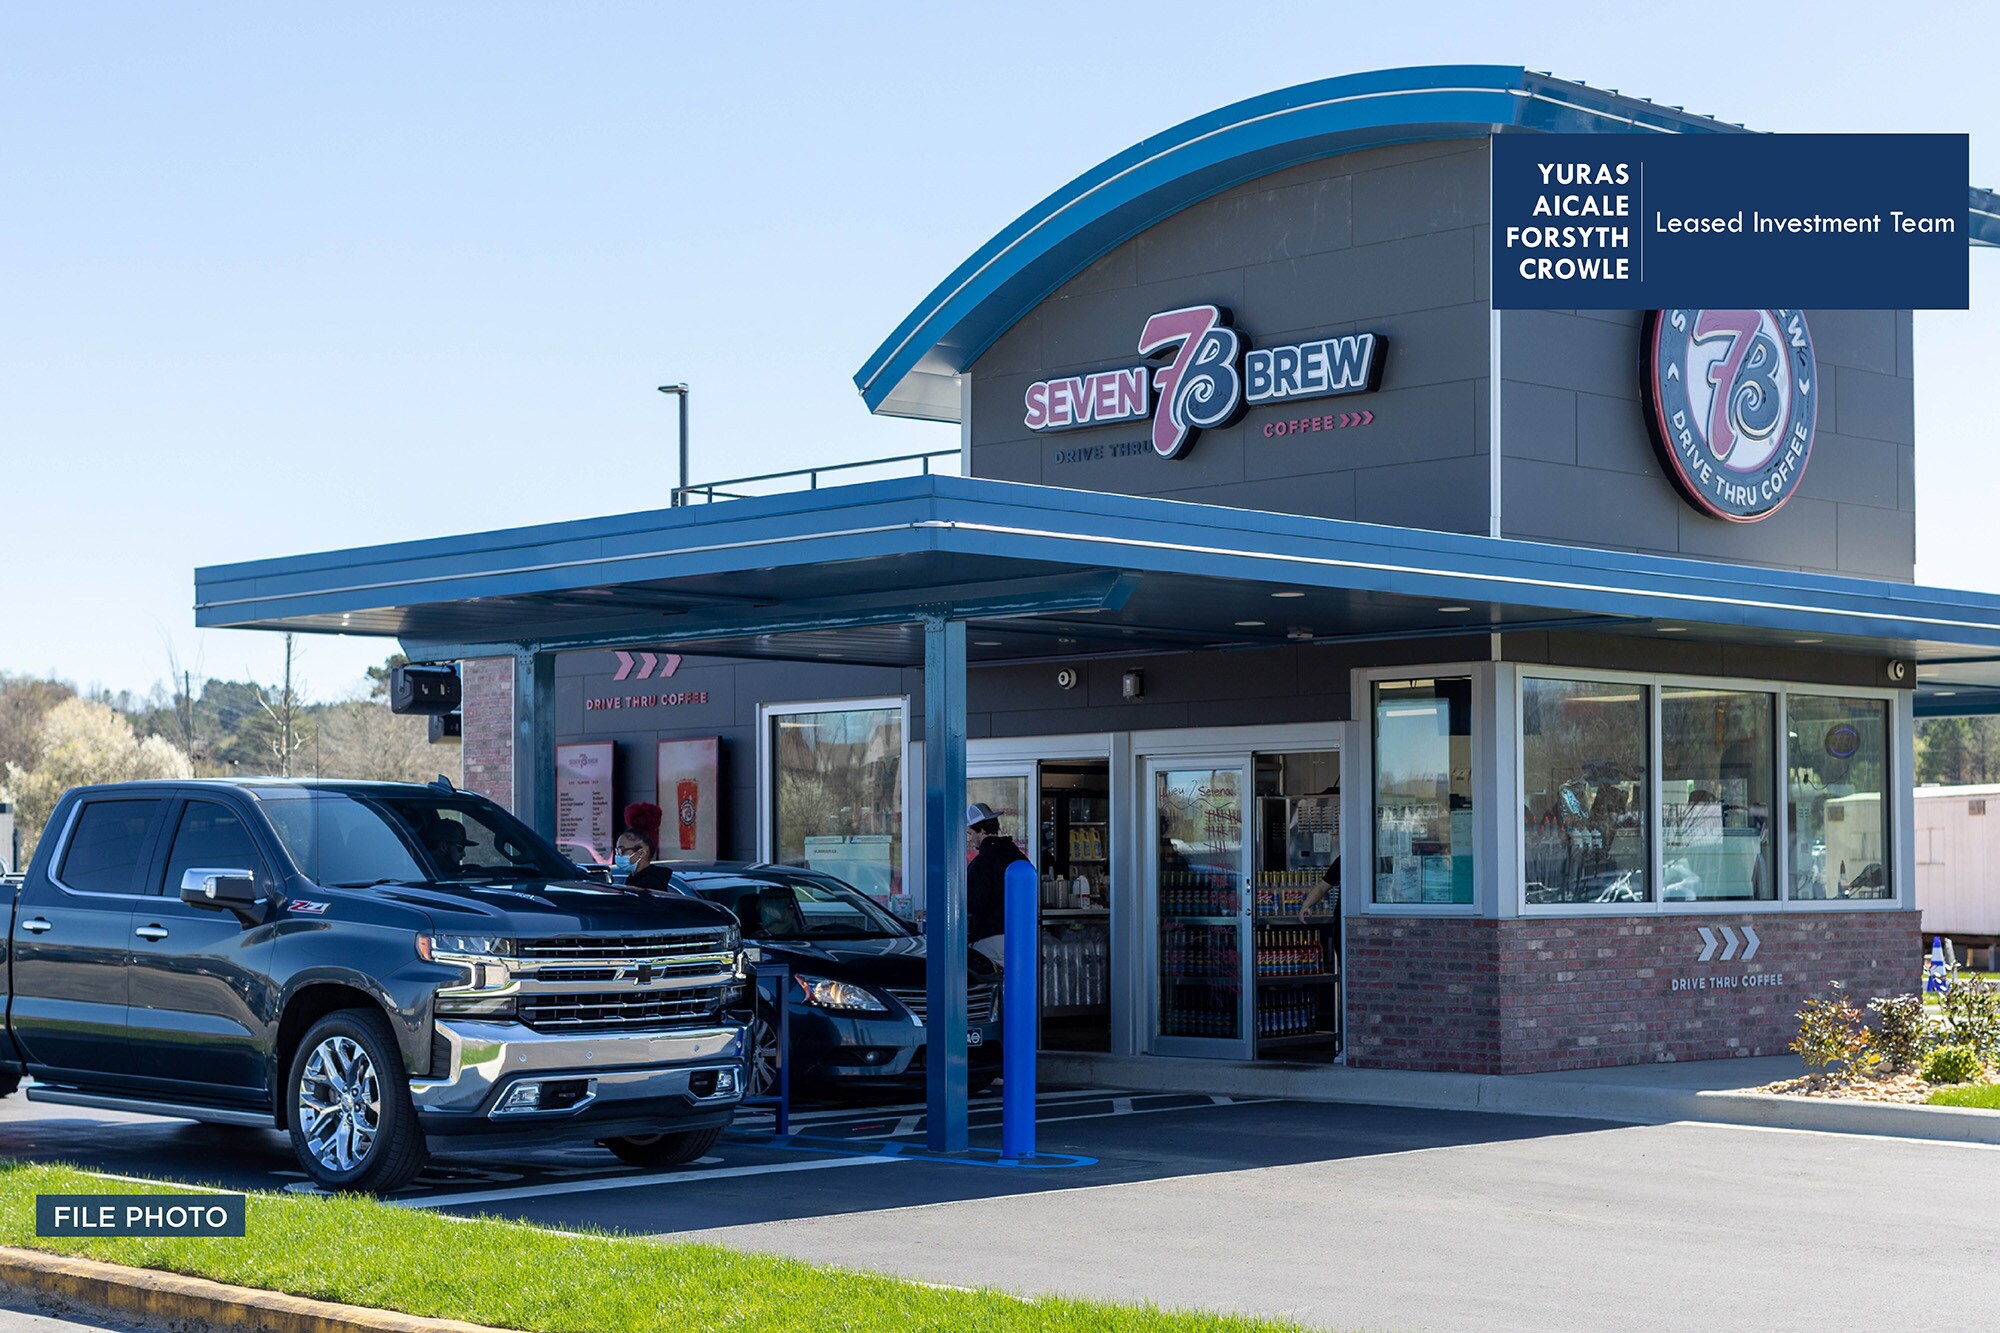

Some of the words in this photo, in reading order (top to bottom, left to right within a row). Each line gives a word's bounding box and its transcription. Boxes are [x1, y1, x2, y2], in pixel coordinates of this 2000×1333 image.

[1024, 366, 1149, 431] SEVEN
[1245, 332, 1378, 405] BREW
[1055, 445, 1104, 464] DRIVE
[1109, 439, 1154, 459] THRU
[1264, 415, 1335, 438] COFFEE
[1673, 410, 1713, 485] DRIVE
[1715, 474, 1757, 506] THRU
[1761, 422, 1808, 500] COFFEE
[586, 698, 622, 711] DRIVE
[625, 695, 657, 708] THRU
[661, 692, 708, 706] COFFEE
[1672, 978, 1706, 991] DRIVE
[1709, 976, 1738, 989] THRU
[1742, 974, 1783, 987] COFFEE
